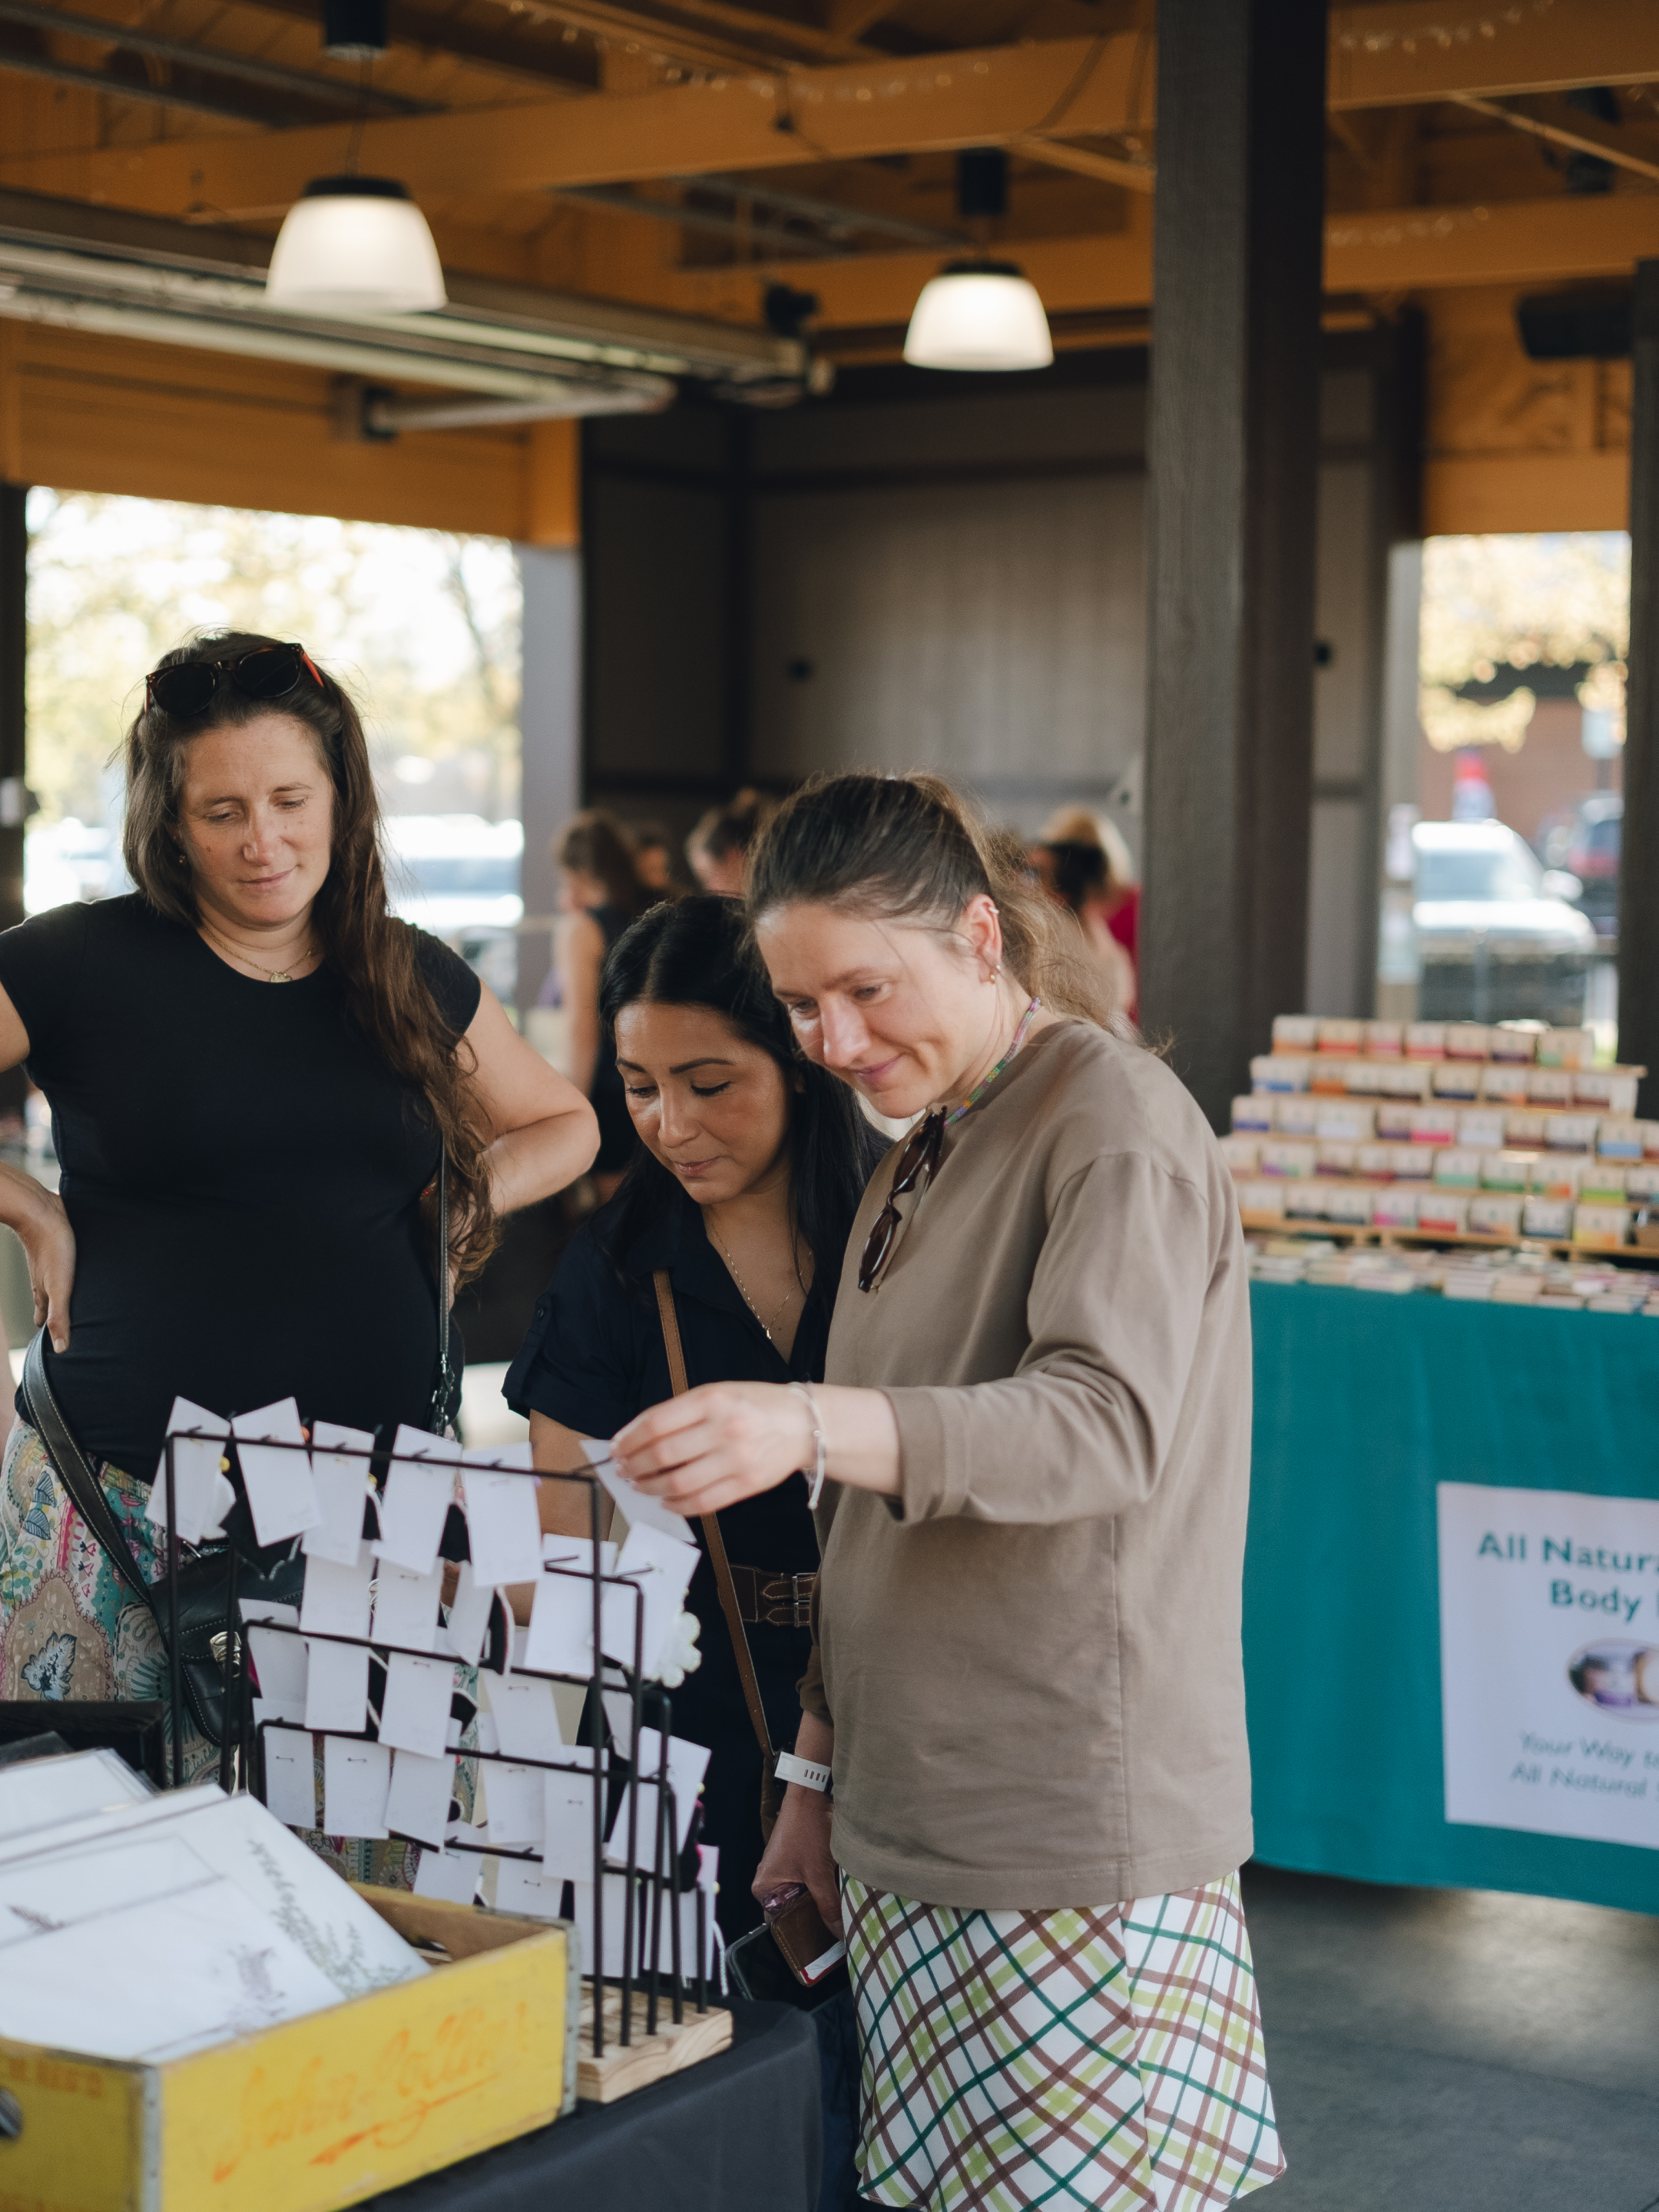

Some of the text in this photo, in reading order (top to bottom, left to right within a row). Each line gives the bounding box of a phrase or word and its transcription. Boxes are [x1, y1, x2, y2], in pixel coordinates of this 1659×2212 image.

[1479, 1532, 1659, 1571] All Natur
[1551, 1579, 1641, 1623] Body
[1550, 1767, 1647, 1799] Natural
